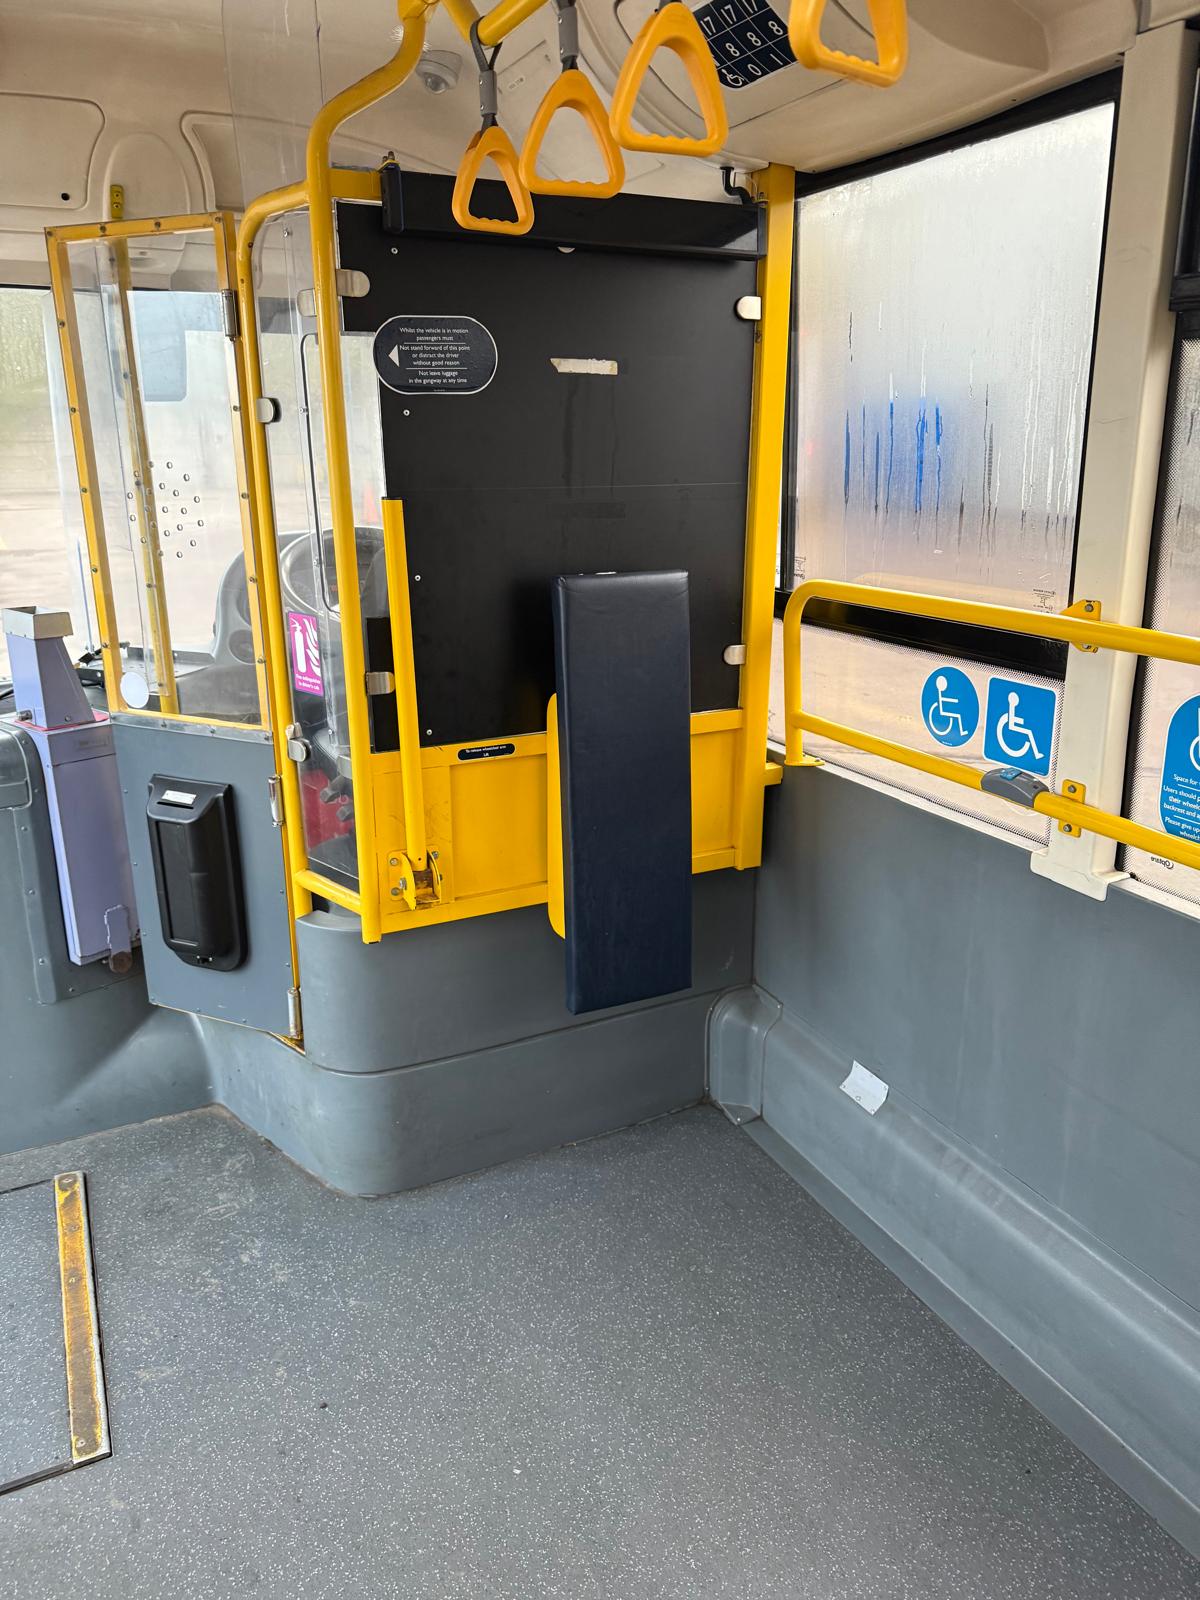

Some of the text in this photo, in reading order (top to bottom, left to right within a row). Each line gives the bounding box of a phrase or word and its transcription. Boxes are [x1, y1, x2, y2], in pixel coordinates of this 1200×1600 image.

[700, 16, 716, 36] 17
[720, 4, 737, 25] 17
[725, 20, 783, 57] 8 8 8
[747, 63, 762, 76] 0
[1173, 773, 1189, 783] Space
[1163, 784, 1178, 795] Users
[1179, 790, 1197, 799] should
[1168, 795, 1181, 804] their
[1163, 802, 1185, 814] backrest
[1164, 816, 1181, 827] Please
